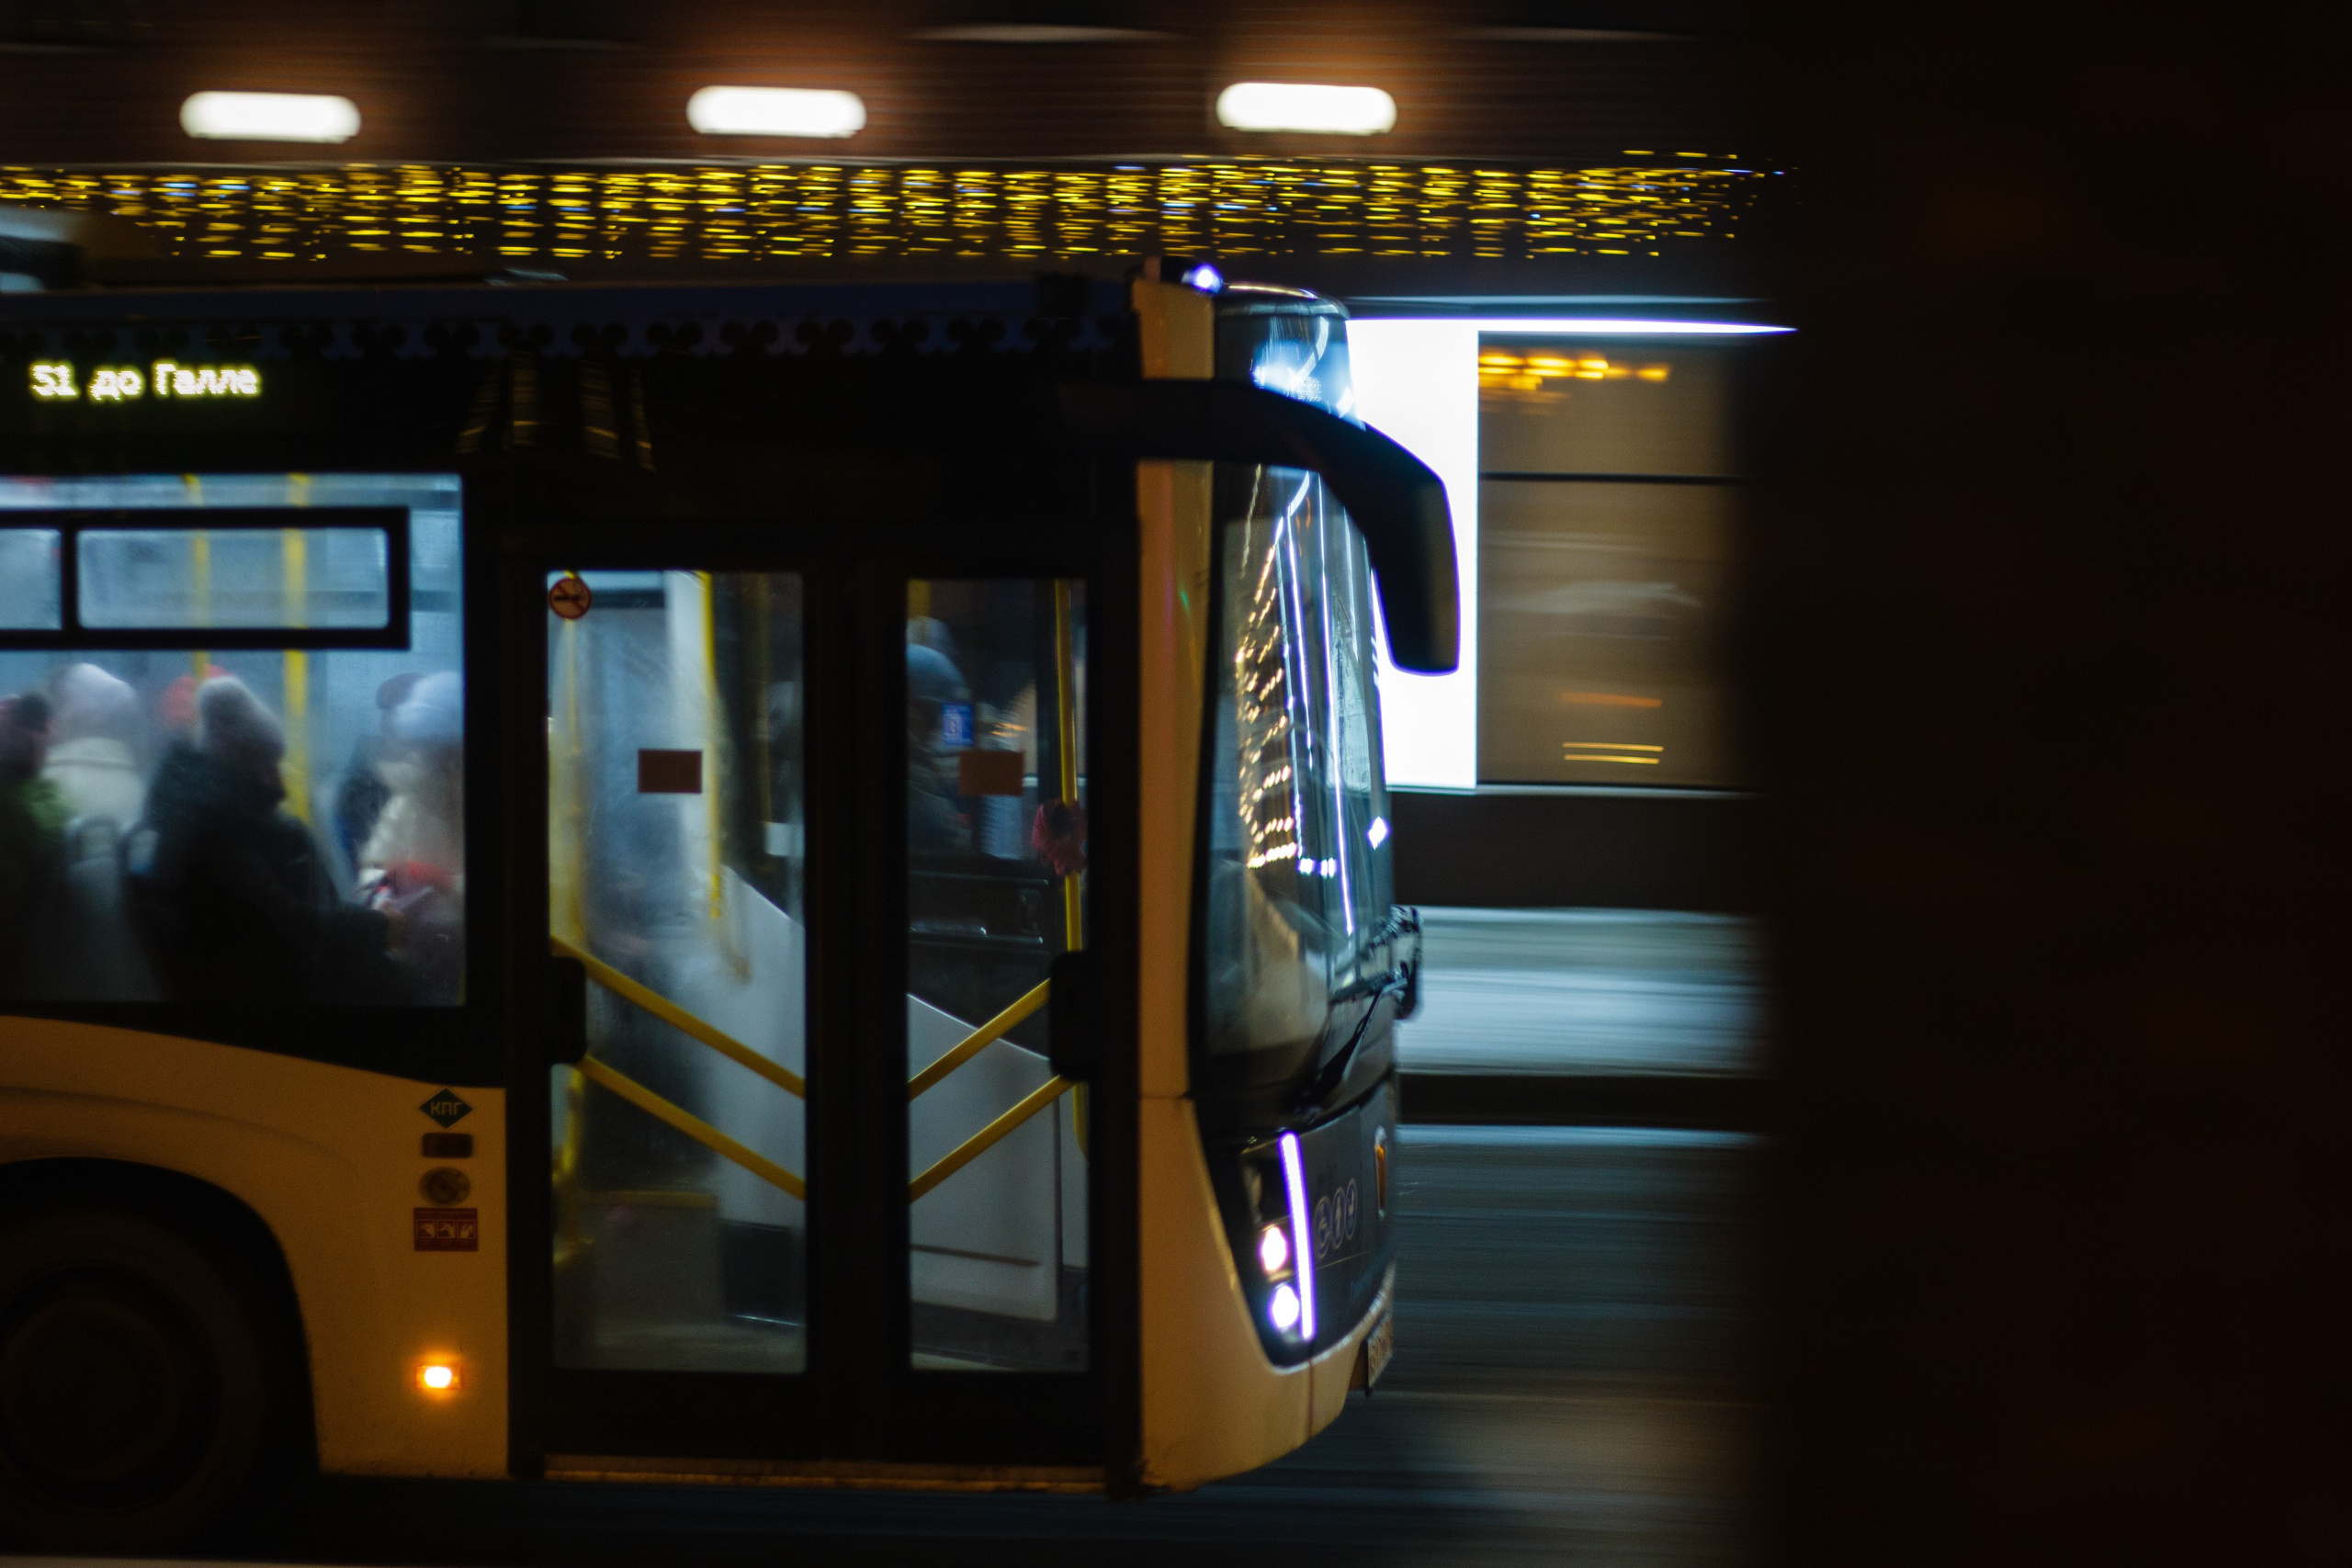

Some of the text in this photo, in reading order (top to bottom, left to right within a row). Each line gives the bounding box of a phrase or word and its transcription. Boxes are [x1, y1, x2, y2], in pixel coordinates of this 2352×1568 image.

[89, 368, 143, 400] до
[153, 362, 259, 396] Галле
[430, 1101, 462, 1116] КПГ
